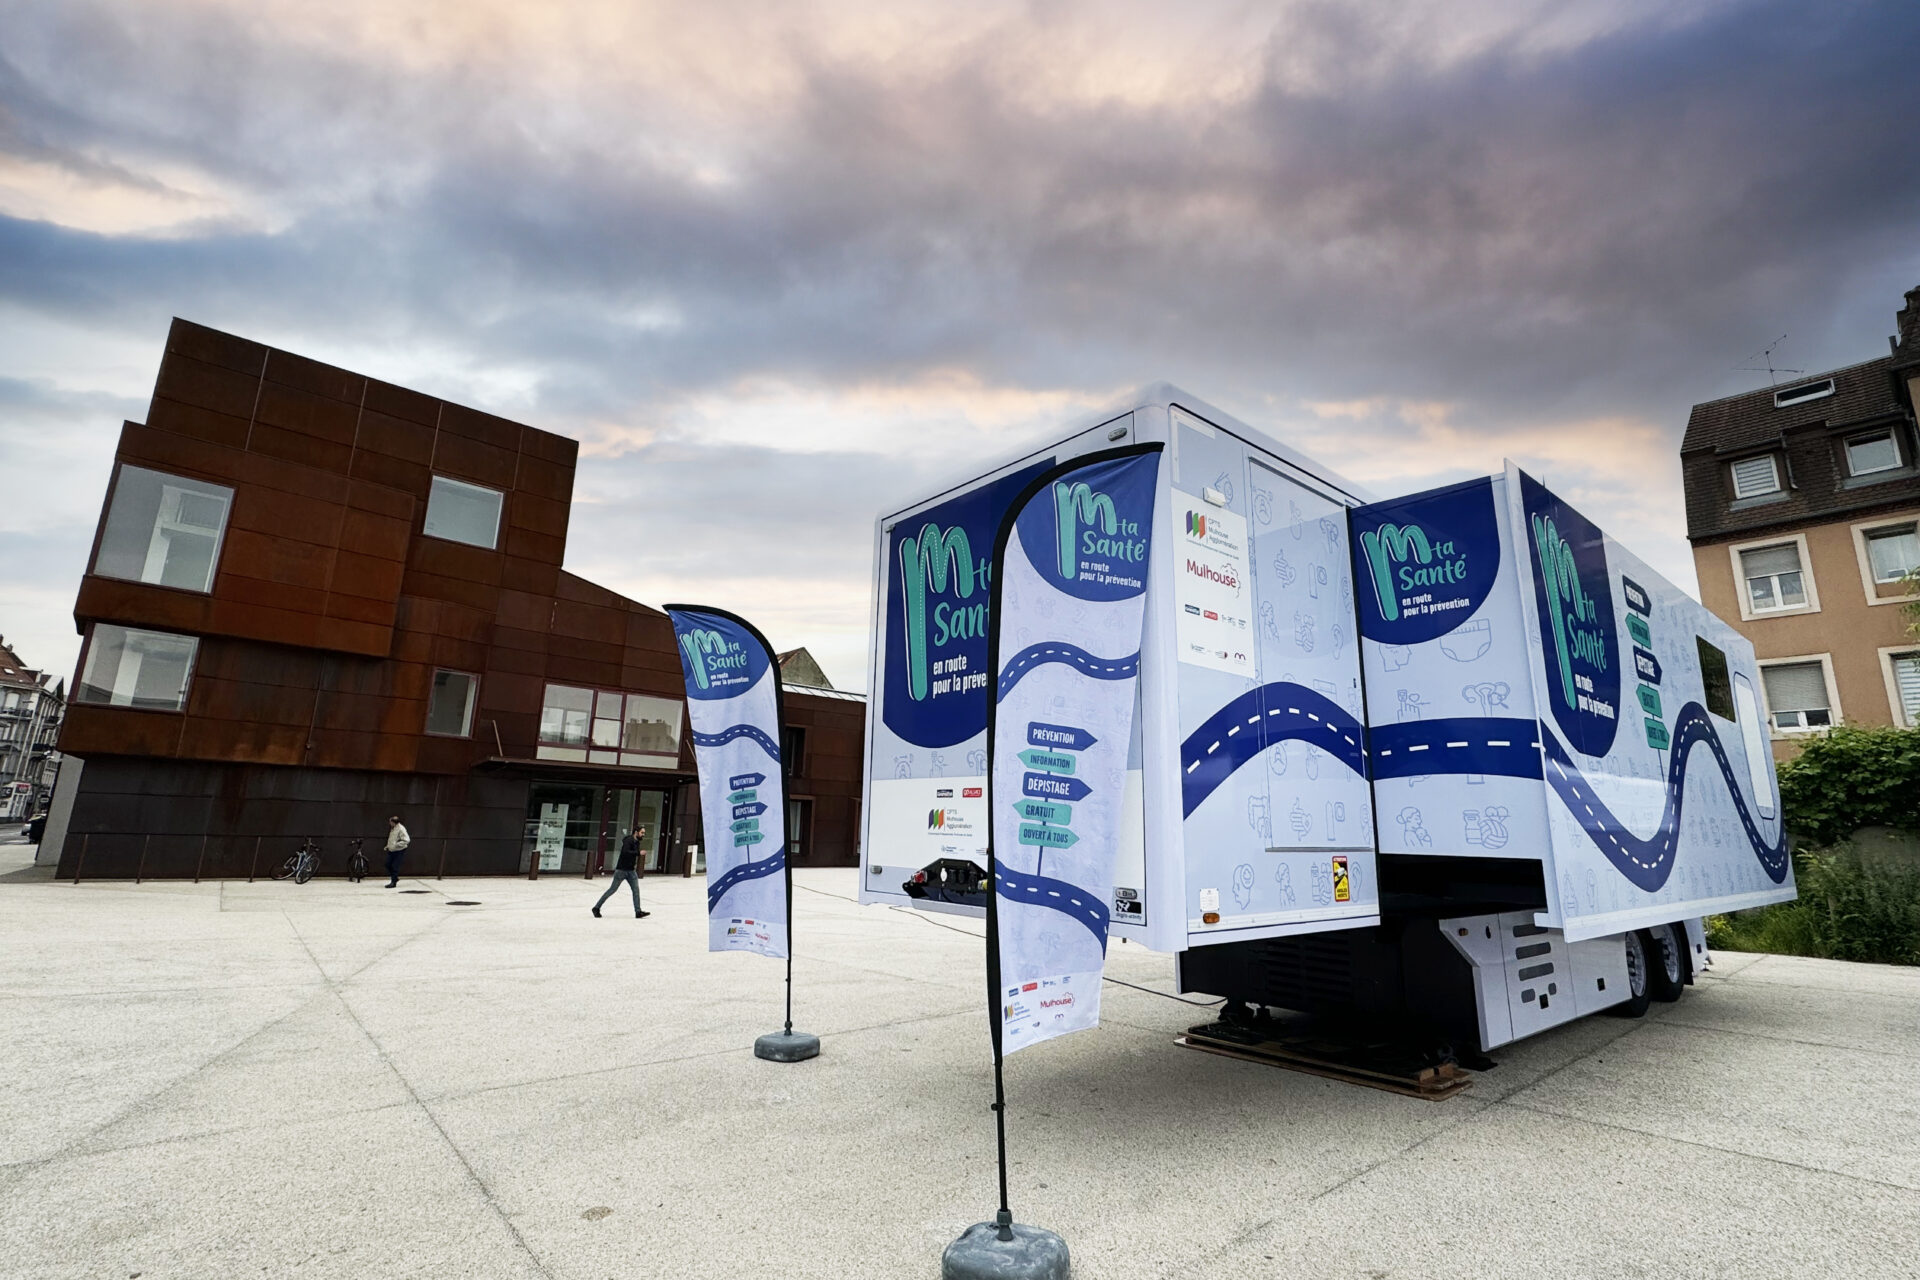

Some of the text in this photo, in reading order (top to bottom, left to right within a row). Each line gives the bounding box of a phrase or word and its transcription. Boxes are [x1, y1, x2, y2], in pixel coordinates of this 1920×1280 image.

[1117, 519, 1138, 536] ta
[1083, 531, 1146, 563] Santé
[1431, 541, 1455, 559] ta
[1081, 561, 1109, 572] en route
[1187, 558, 1237, 588] Mulhouse
[1399, 554, 1467, 591] Santé
[1080, 572, 1141, 588] pour la prévention
[1402, 593, 1432, 606] en route
[1403, 598, 1470, 619] pour la prévention
[1581, 591, 1597, 624] ta
[727, 642, 740, 653] ta
[1567, 613, 1607, 673] Santé
[707, 650, 747, 671] Santé
[933, 654, 967, 675] en route
[933, 670, 988, 699] pour la préve
[1032, 728, 1075, 744] PRÉVENTION
[1030, 755, 1070, 769] INFORMATION
[1027, 776, 1070, 795] DÉPISTAGE
[1026, 804, 1055, 819] GRATUIT
[1023, 828, 1046, 840] OUVERT
[1053, 832, 1069, 844] TOUS
[1040, 998, 1072, 1008] Mulhouse
